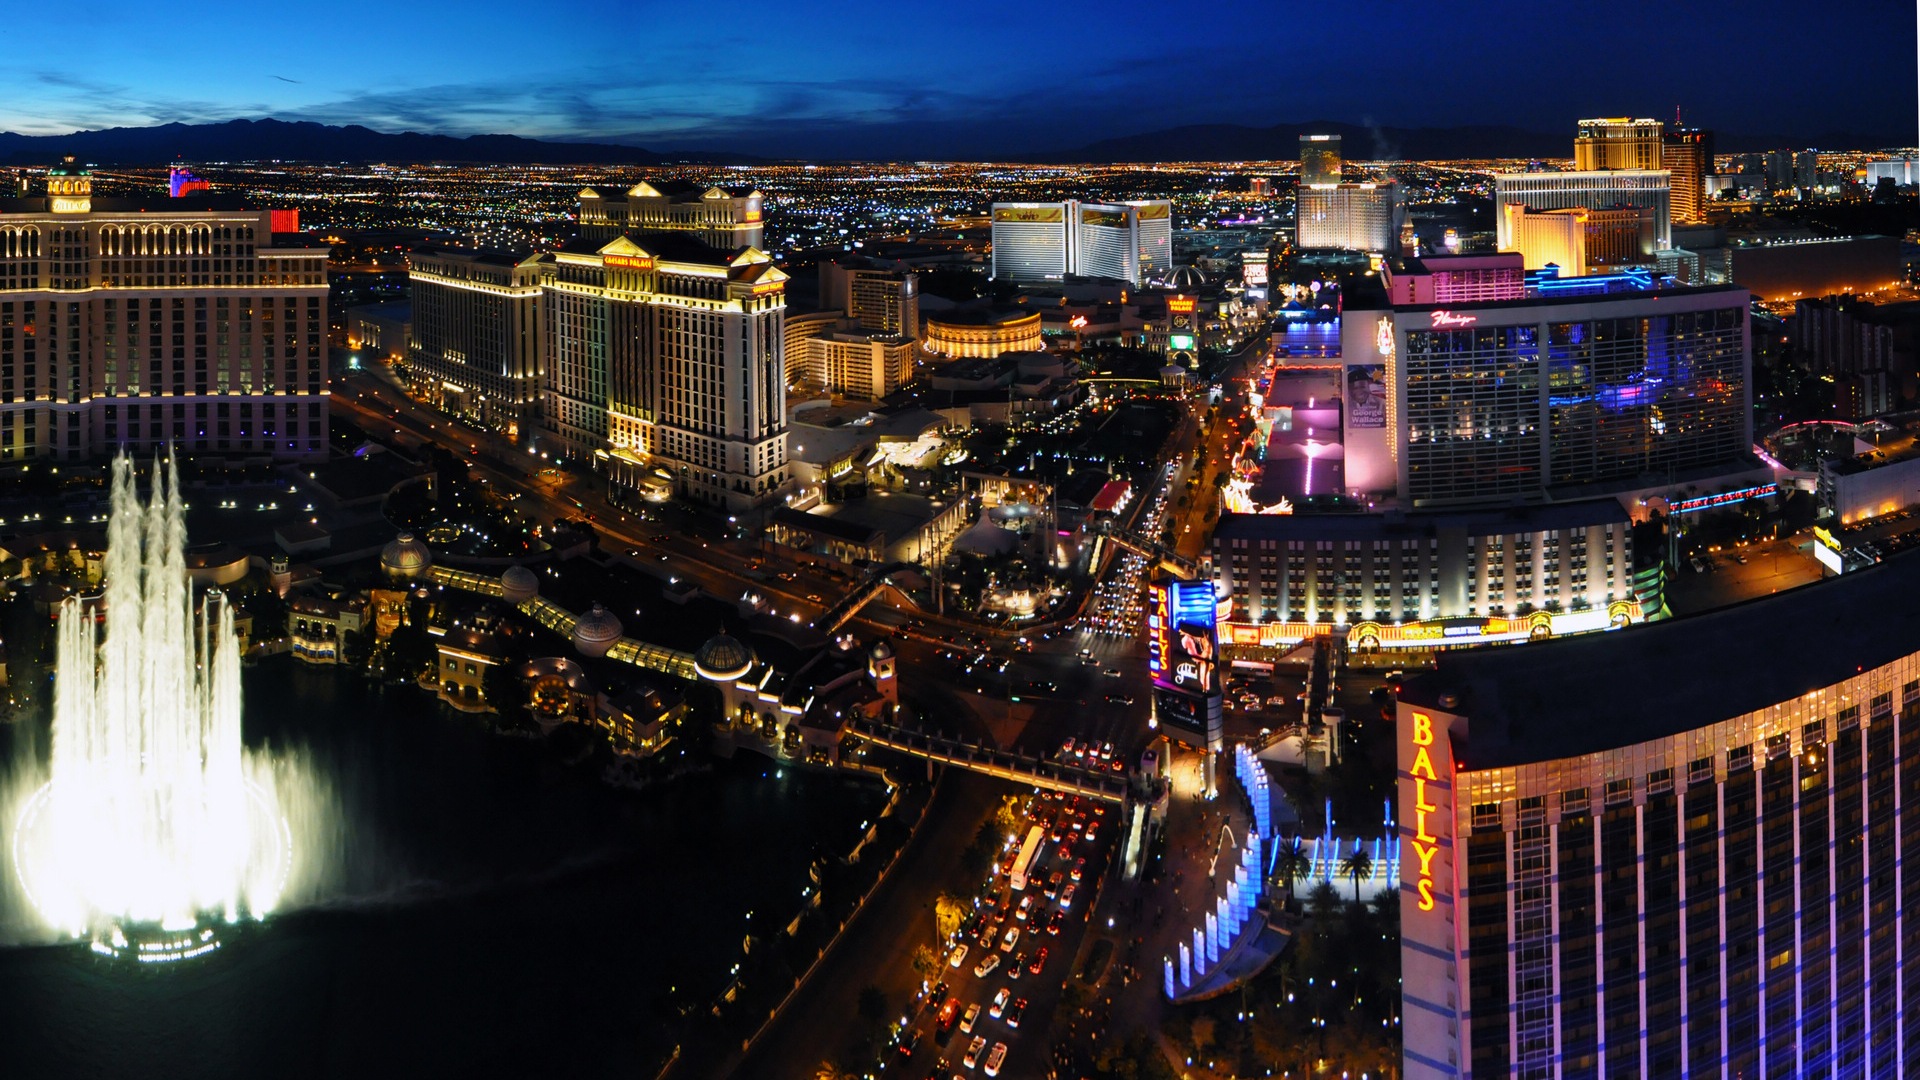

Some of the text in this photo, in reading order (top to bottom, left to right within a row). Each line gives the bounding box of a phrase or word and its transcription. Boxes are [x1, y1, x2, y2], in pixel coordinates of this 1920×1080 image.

[604, 256, 652, 269] CAESARS PALACE
[1430, 310, 1476, 327] Flamingo
[1352, 409, 1382, 417] George
[1410, 712, 1438, 911] BALLYS
